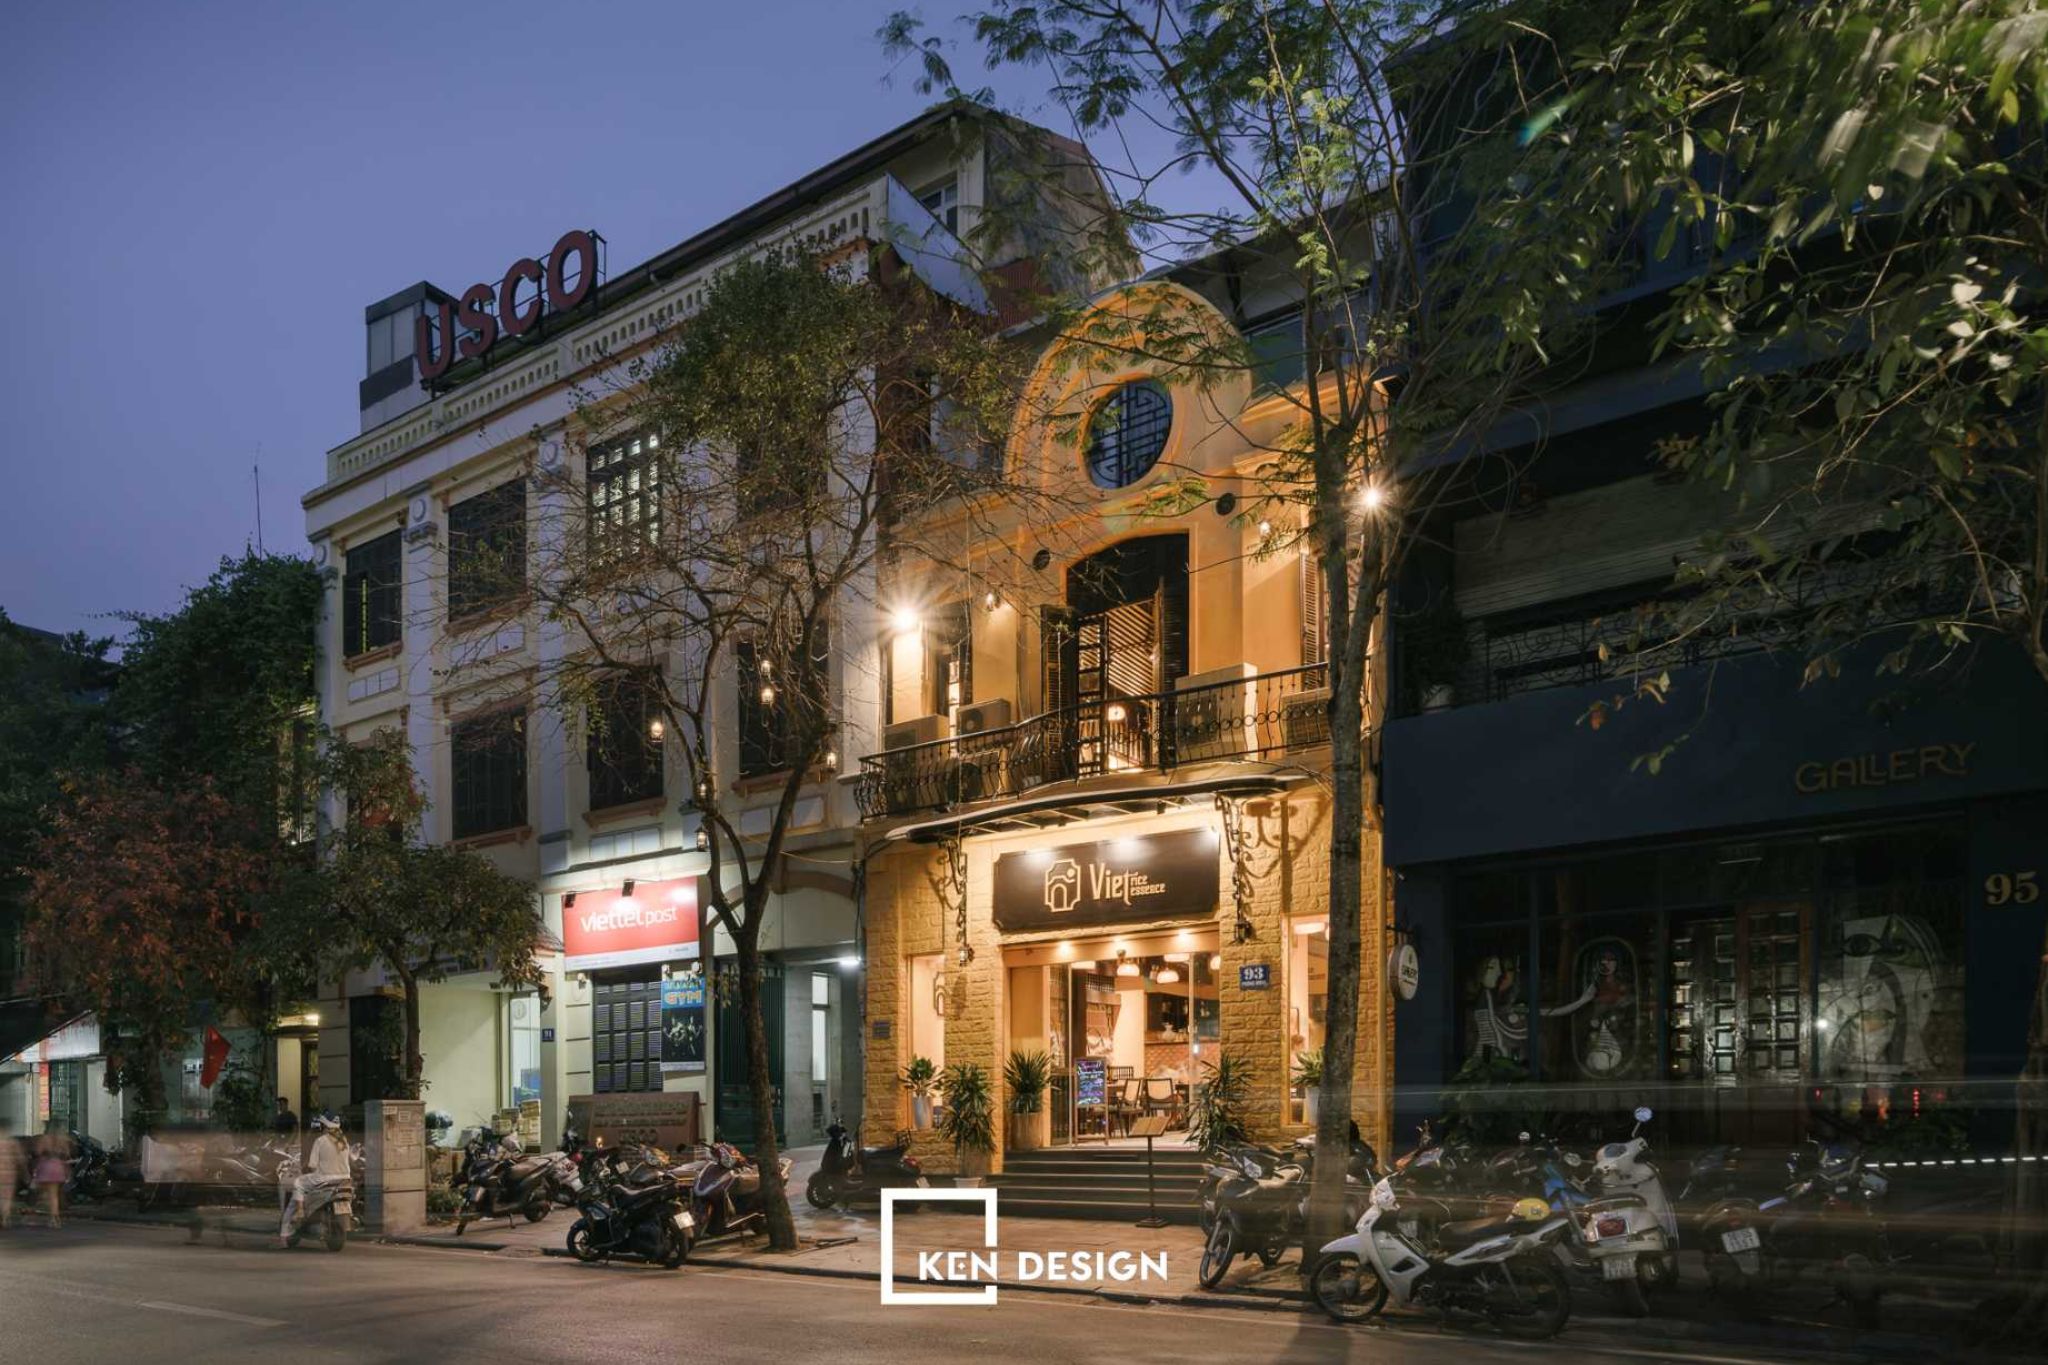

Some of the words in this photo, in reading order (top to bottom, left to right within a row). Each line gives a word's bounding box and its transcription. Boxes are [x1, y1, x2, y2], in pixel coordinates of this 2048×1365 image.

[417, 230, 598, 379] USCO
[1795, 742, 1977, 793] GALLERY
[1984, 870, 2039, 904] 95
[1243, 966, 1266, 980] 93
